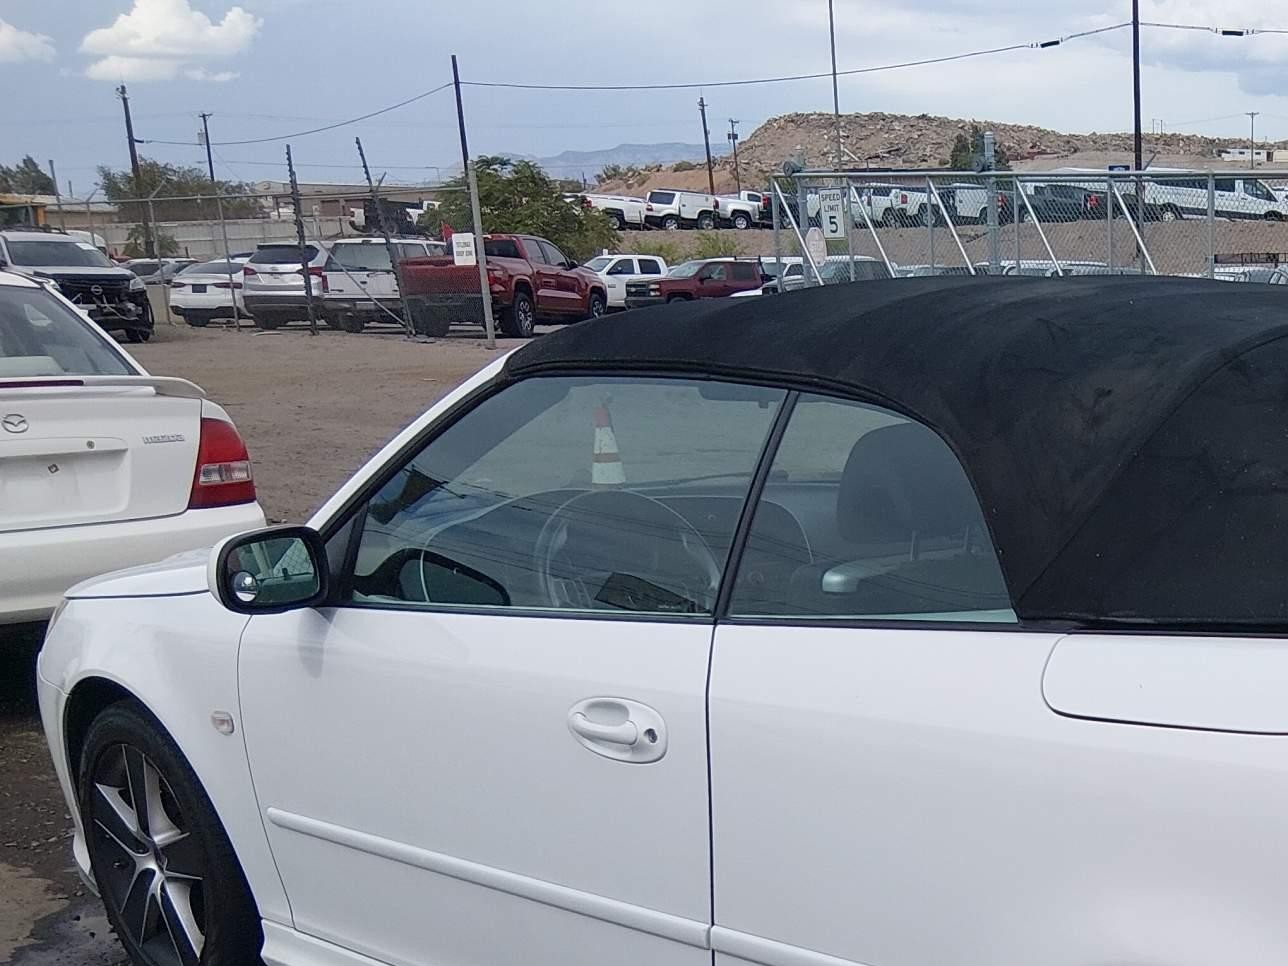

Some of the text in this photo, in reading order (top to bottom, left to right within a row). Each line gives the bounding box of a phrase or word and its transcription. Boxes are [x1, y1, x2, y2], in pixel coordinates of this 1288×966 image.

[820, 193, 841, 202] SPEED
[823, 204, 840, 213] LIMIT
[828, 215, 839, 234] 5
